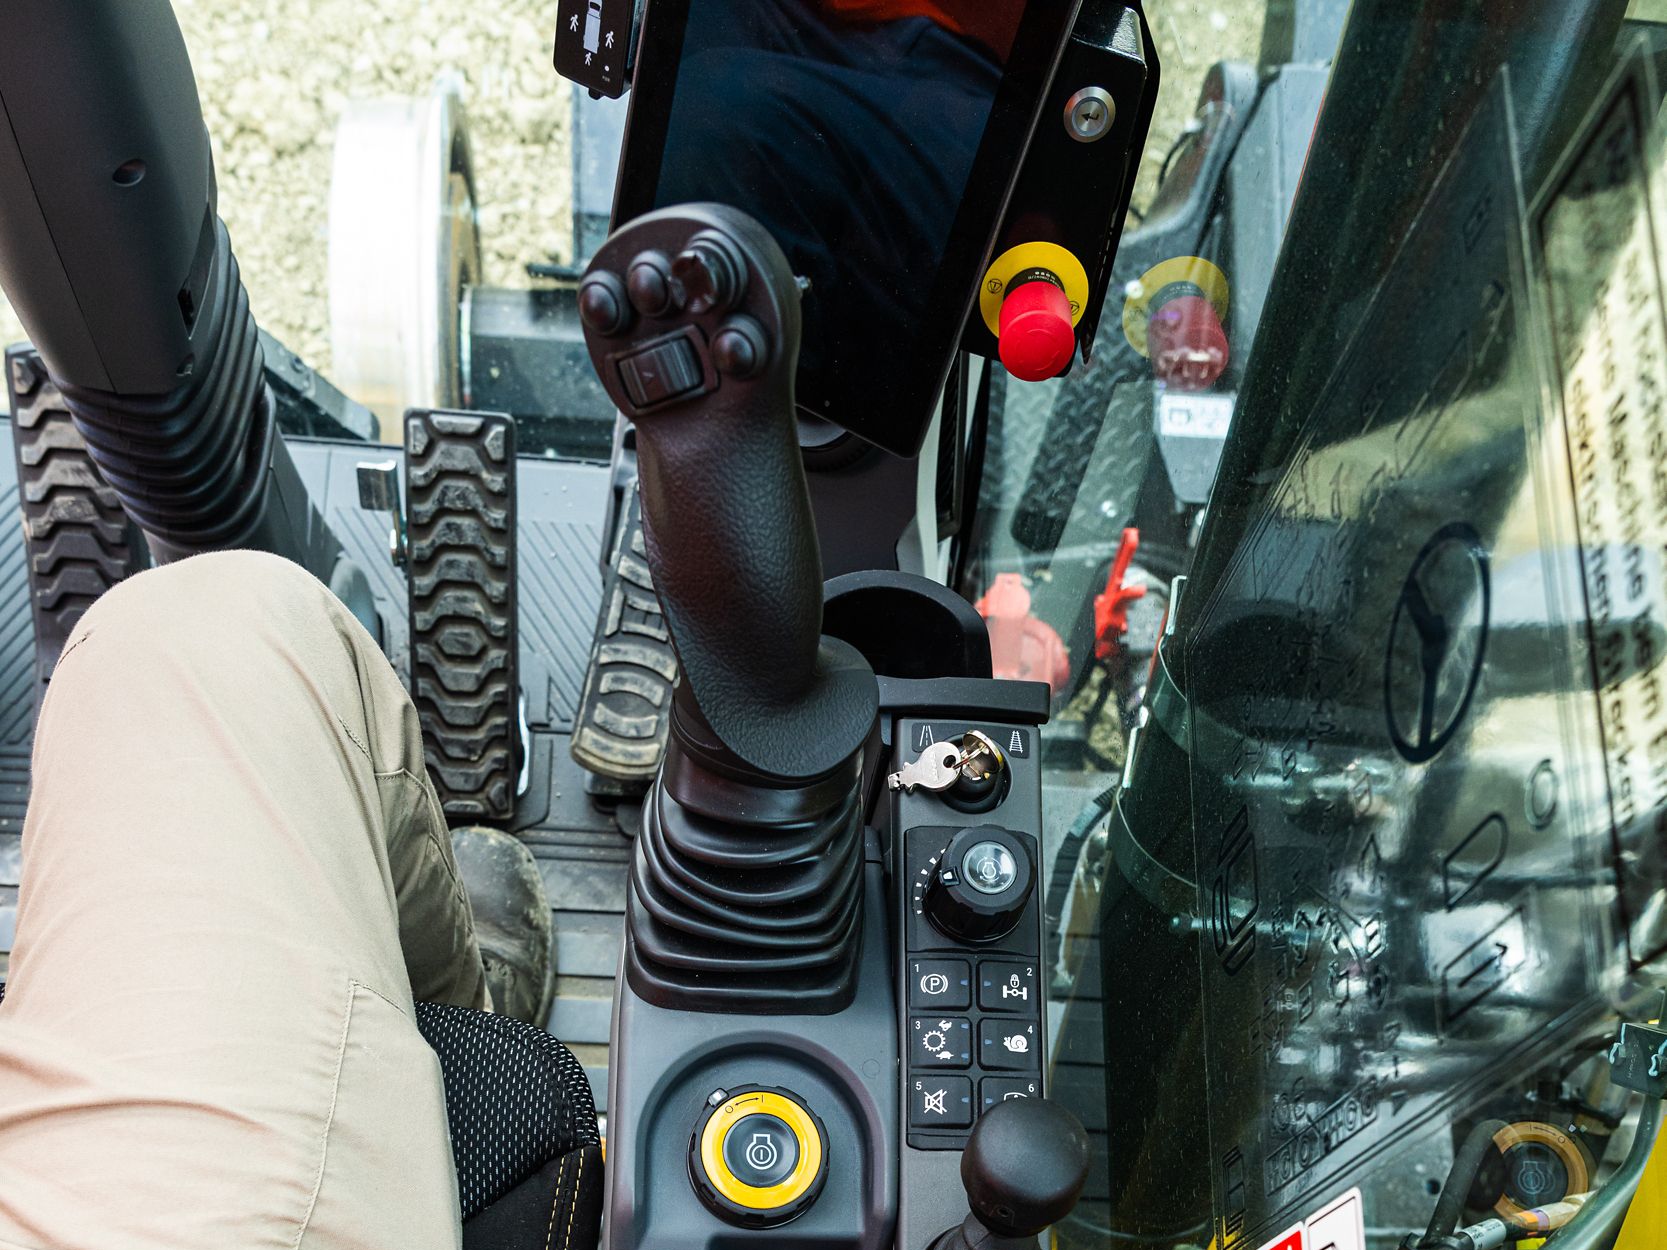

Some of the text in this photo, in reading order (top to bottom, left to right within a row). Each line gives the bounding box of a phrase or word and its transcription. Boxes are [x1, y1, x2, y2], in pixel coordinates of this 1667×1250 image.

[1607, 392, 1647, 601] Maschine
[1026, 967, 1033, 976] 2
[915, 1021, 921, 1030] 3
[1027, 1025, 1033, 1034] 4
[915, 1081, 922, 1090] 5
[1028, 1084, 1035, 1093] 6
